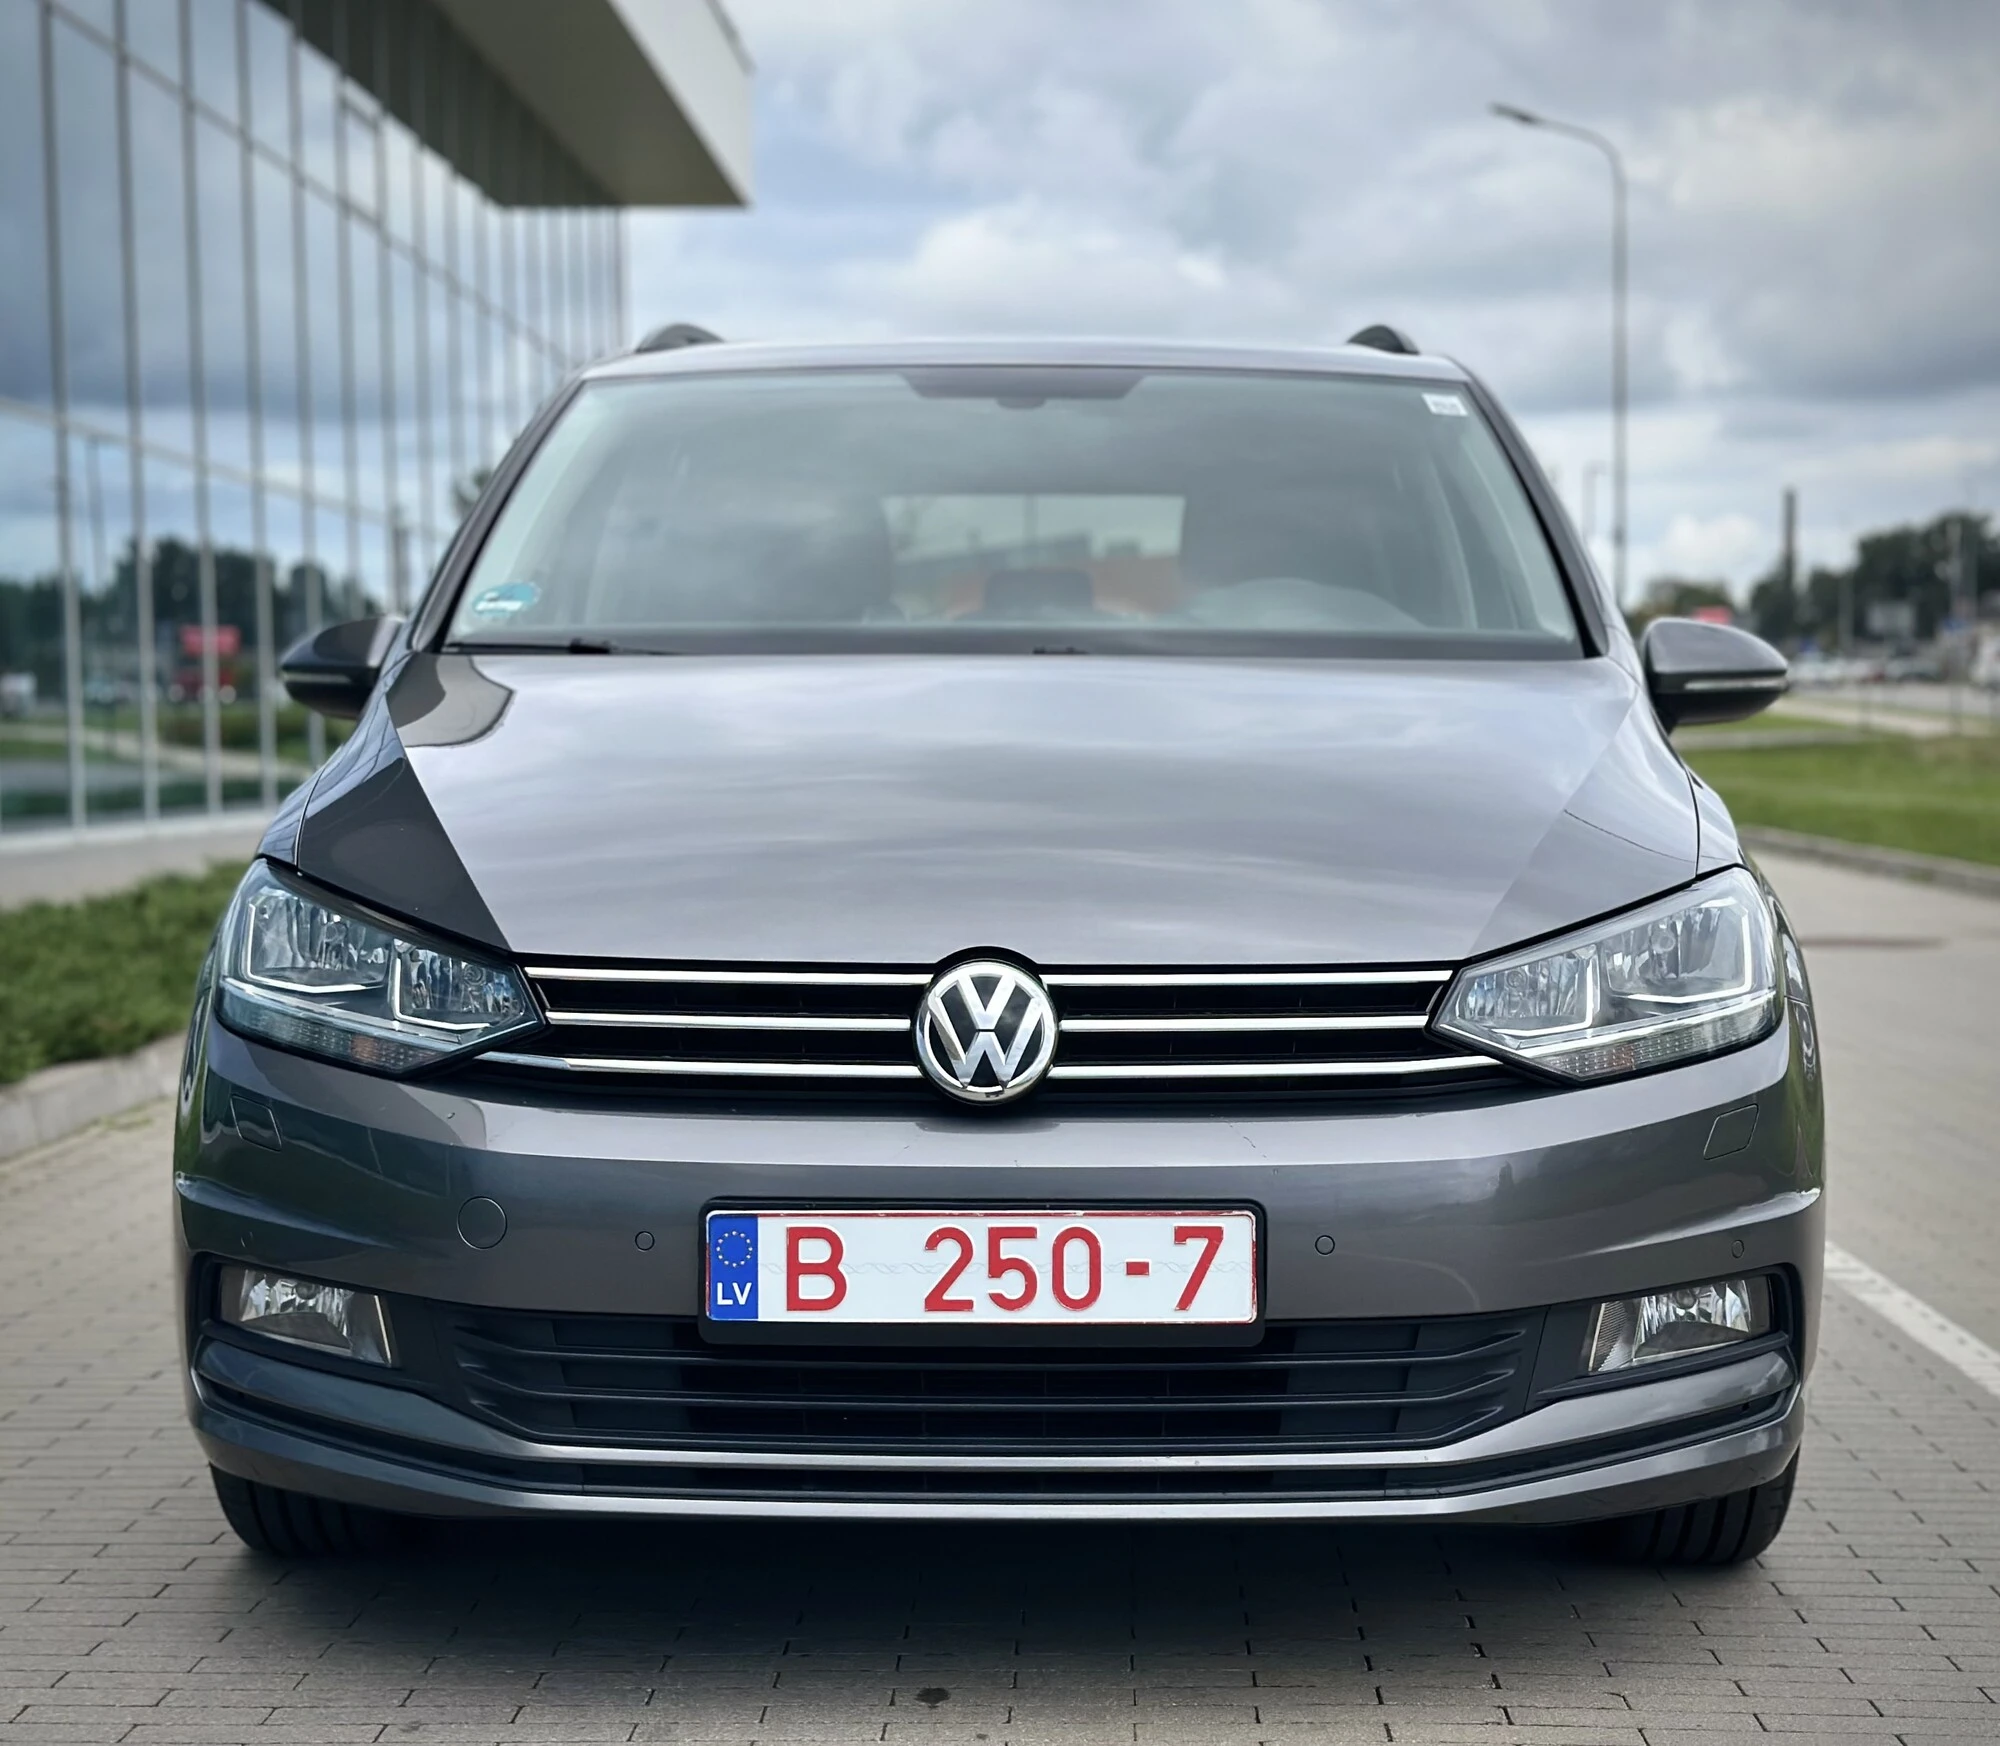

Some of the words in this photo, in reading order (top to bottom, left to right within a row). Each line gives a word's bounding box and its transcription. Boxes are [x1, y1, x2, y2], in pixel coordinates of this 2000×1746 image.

[923, 965, 1050, 1091] VW
[716, 1282, 752, 1306] LV
[785, 1226, 847, 1312] B
[923, 1226, 1225, 1312] 250-7
